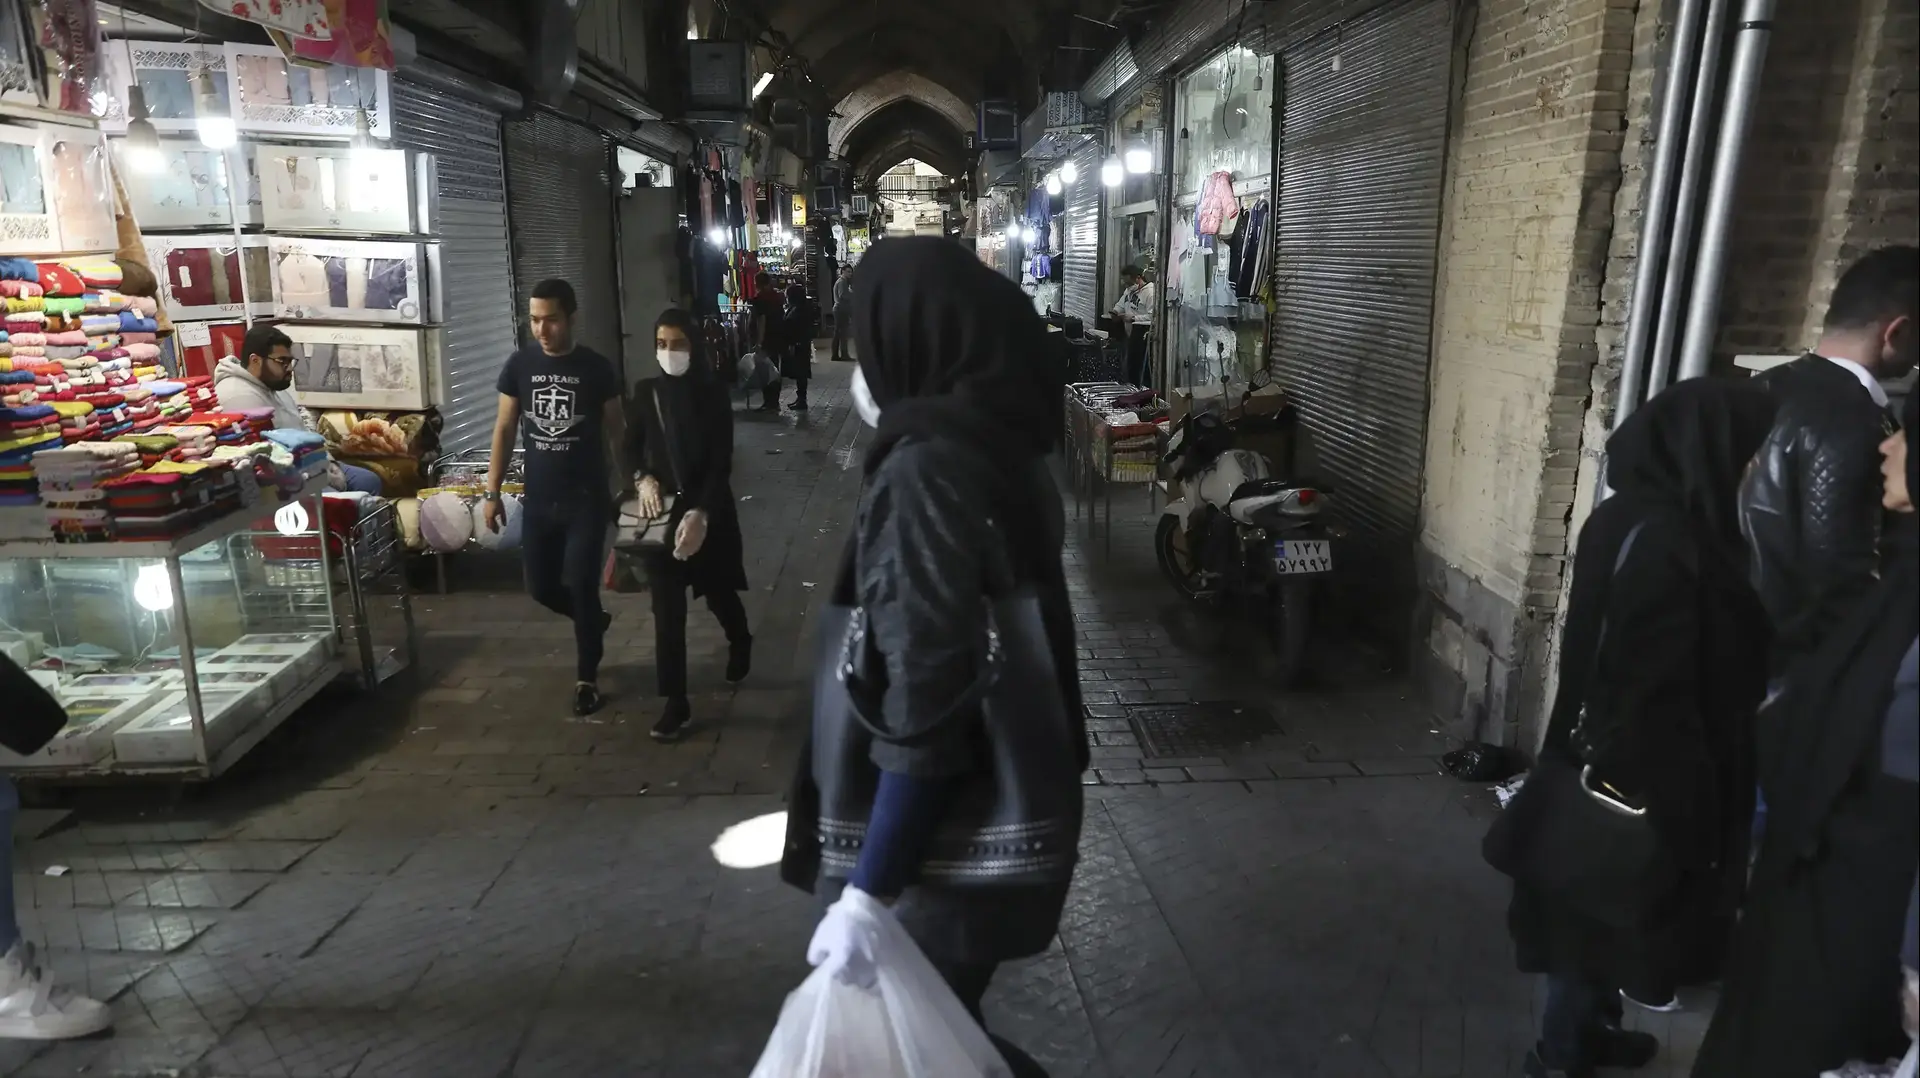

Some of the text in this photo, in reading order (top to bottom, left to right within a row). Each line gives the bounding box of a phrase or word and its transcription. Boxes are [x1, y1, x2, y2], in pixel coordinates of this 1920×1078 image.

[531, 374, 580, 384] 100 YEARS
[1294, 542, 1321, 555] ۱۳۷
